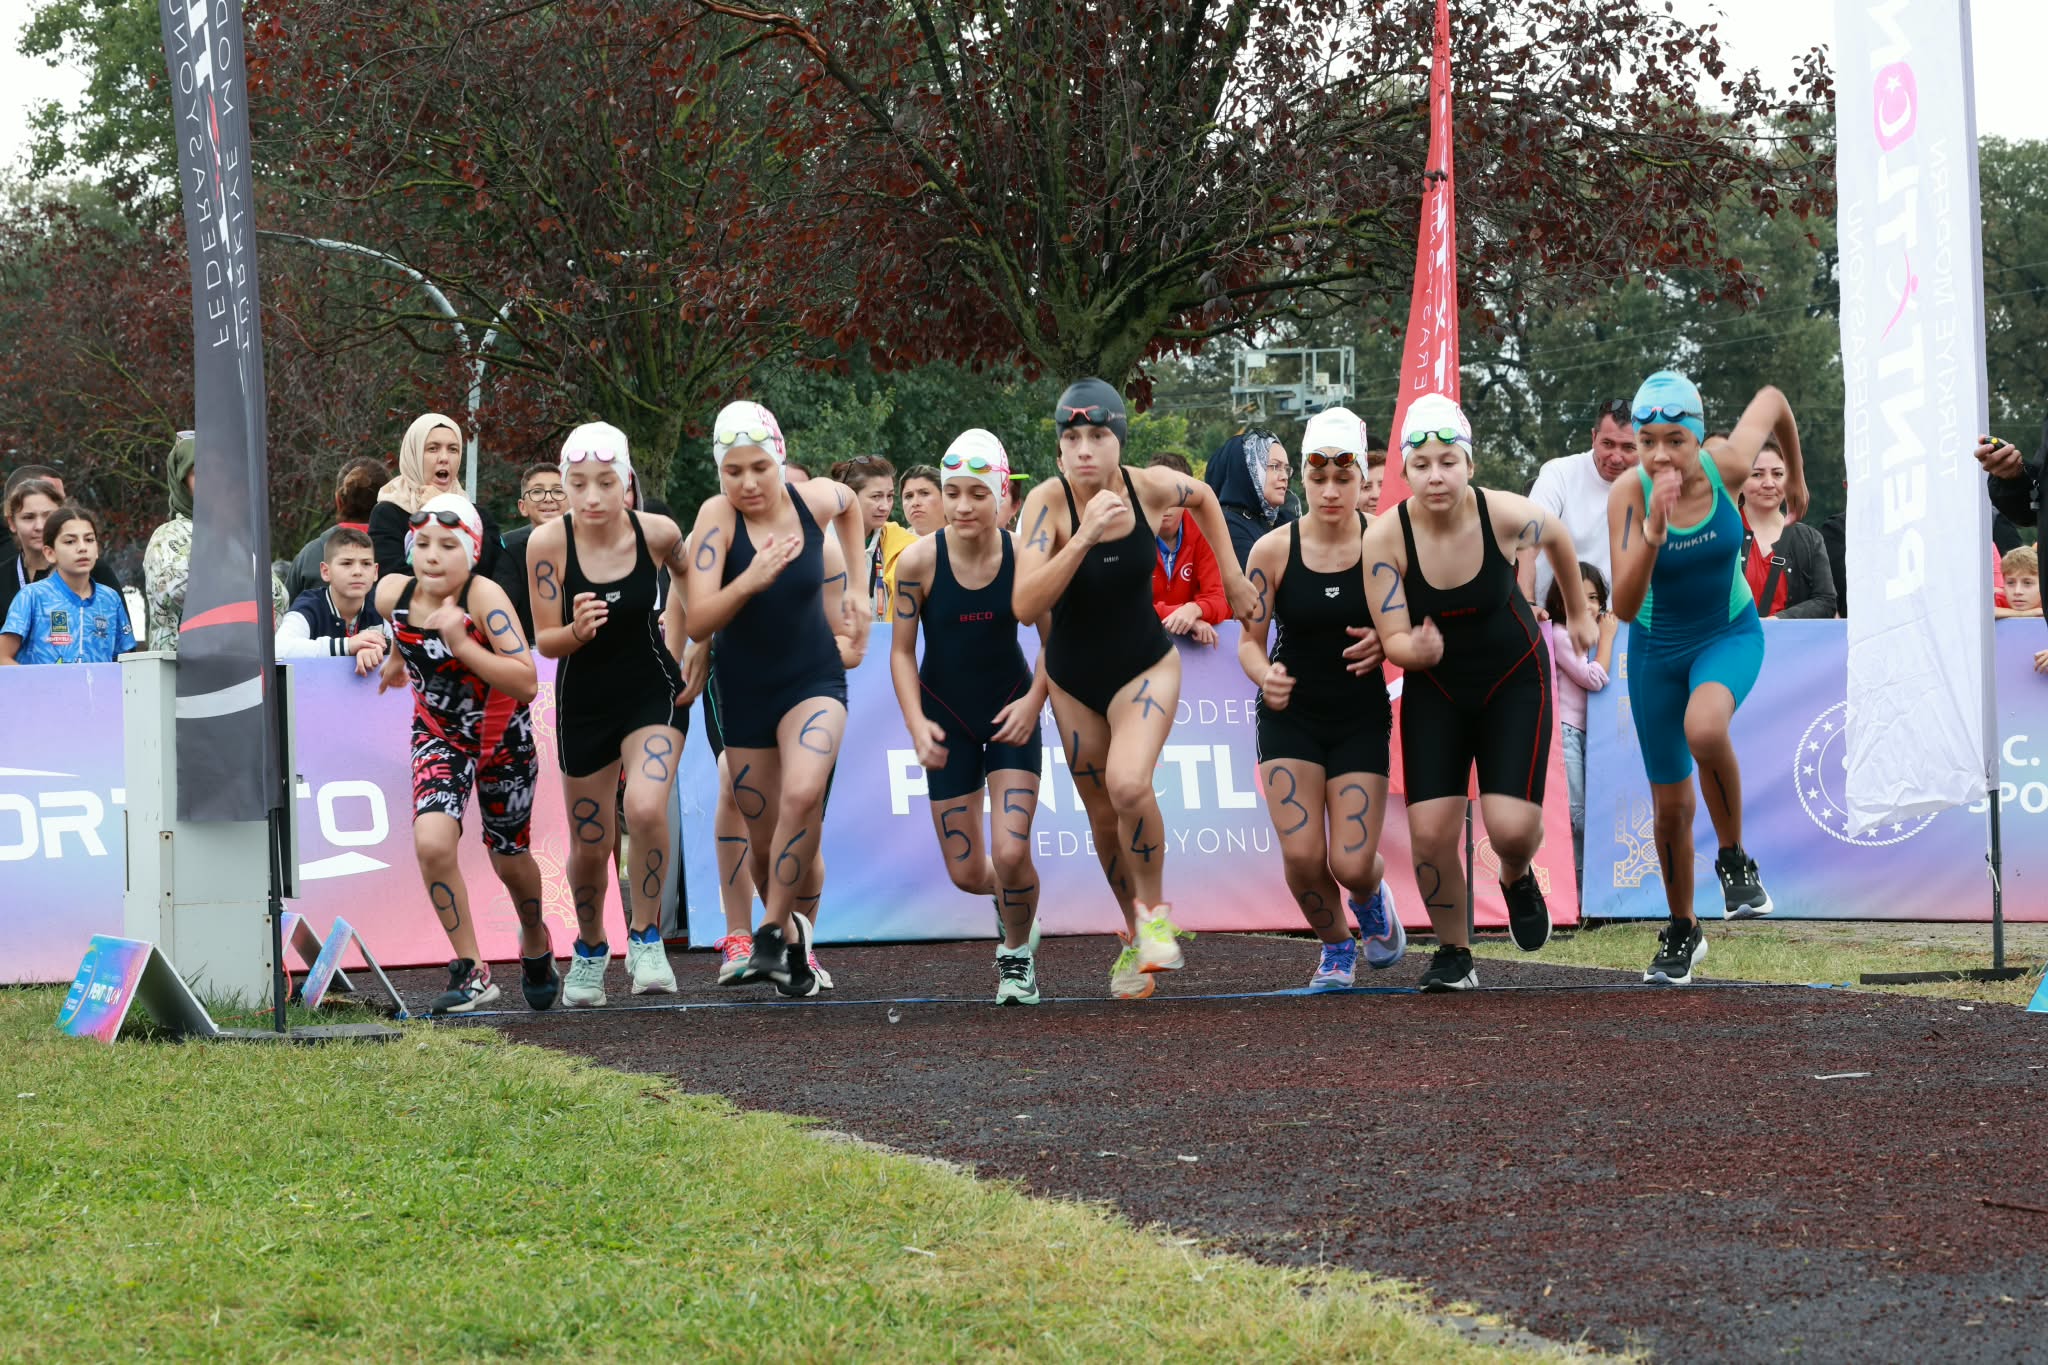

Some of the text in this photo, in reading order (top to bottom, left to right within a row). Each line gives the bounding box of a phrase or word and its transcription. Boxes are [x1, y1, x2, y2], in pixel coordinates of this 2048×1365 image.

[695, 526, 721, 572] 6
[1025, 504, 1050, 552] 4
[896, 580, 921, 619] 5
[1371, 561, 1406, 614] 2
[486, 608, 525, 655] 9
[959, 611, 994, 623] BECO
[1131, 678, 1166, 719] 4
[798, 709, 834, 756] 6
[2002, 734, 2041, 767] C.
[642, 734, 673, 783] 8
[1070, 730, 1106, 789] 4
[733, 763, 767, 820] 6
[1003, 787, 1035, 841] 5
[1268, 766, 1309, 836] 3
[572, 797, 605, 844] 8
[940, 805, 971, 862] 5
[1130, 816, 1159, 863] 4
[1338, 783, 1369, 854] 3
[642, 848, 663, 899] 8
[717, 836, 749, 887] 7
[775, 828, 808, 887] 6
[430, 880, 461, 933] 9
[1416, 861, 1455, 910] 2
[1299, 891, 1335, 930] 3
